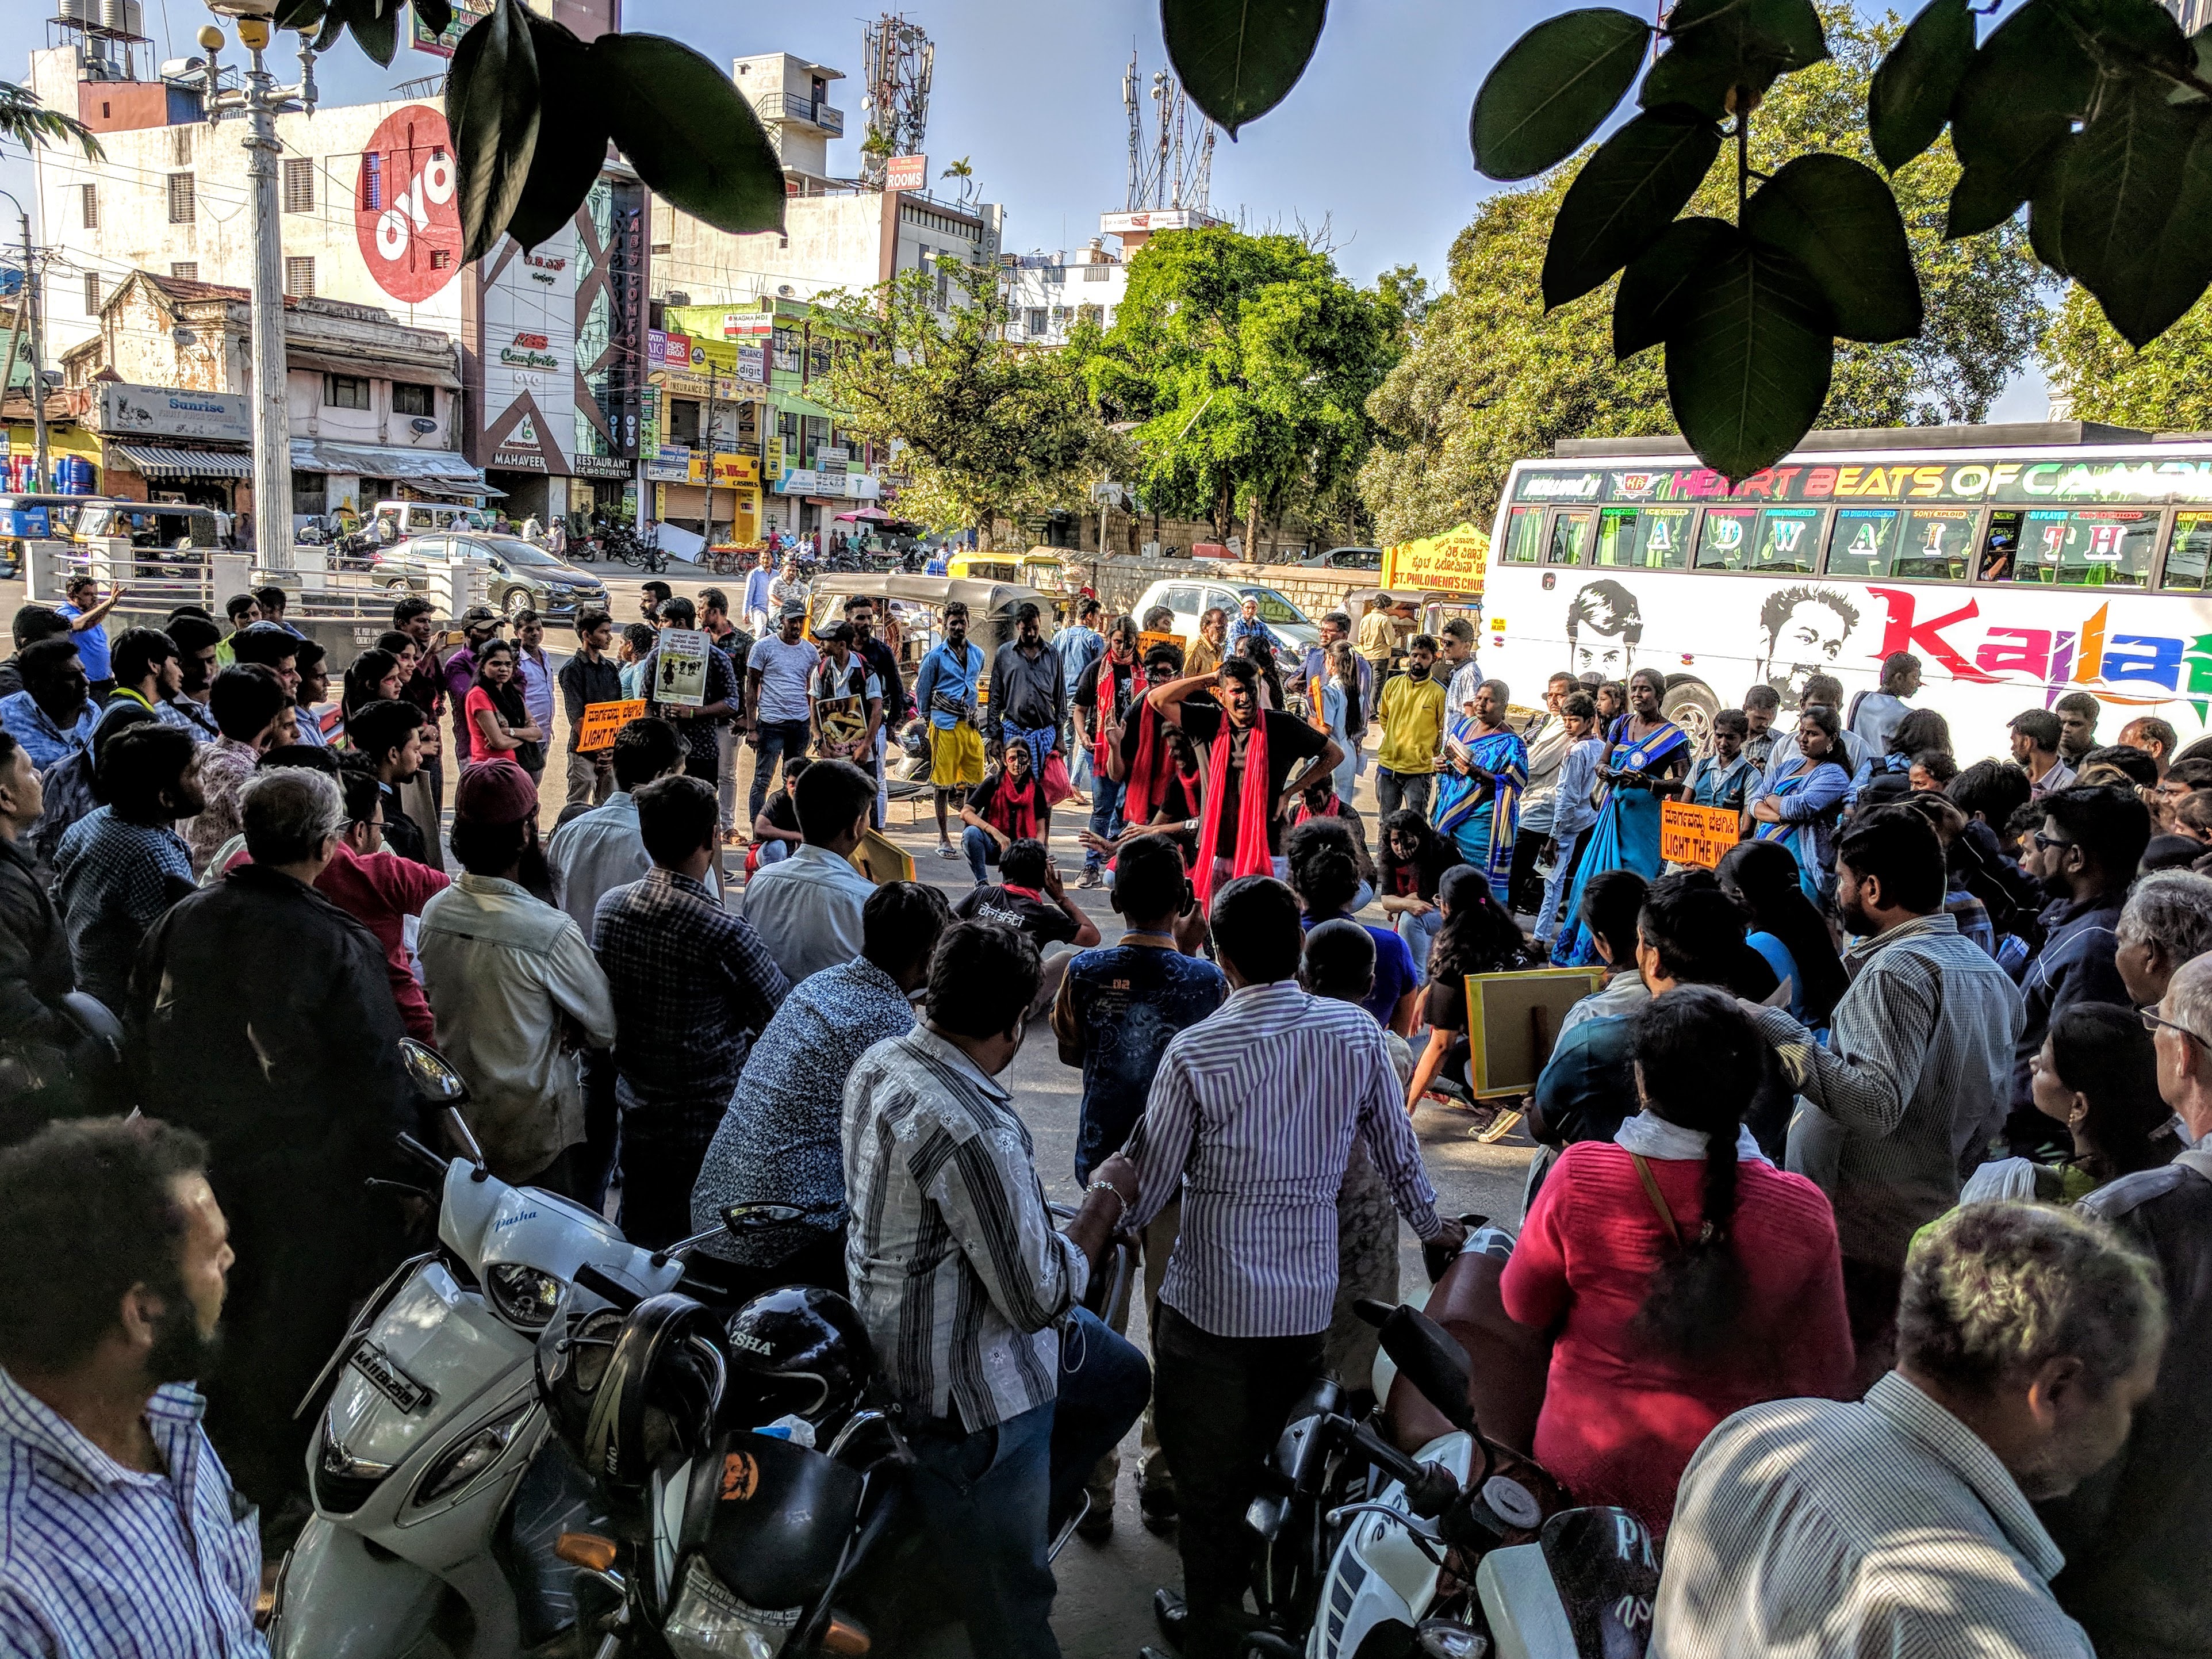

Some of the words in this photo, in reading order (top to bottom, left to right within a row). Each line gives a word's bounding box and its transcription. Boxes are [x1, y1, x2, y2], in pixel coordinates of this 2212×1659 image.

[888, 172, 922, 187] ROOMS
[668, 340, 685, 350] HDFC
[667, 349, 685, 358] ERGO
[739, 363, 761, 377] digit
[670, 381, 701, 394] INSURANCE
[169, 398, 225, 413] Sunrise
[769, 438, 780, 447] Easy
[494, 453, 546, 468] MAHAVEER
[576, 455, 631, 469] RESTAURANT
[605, 469, 620, 477] PURE
[620, 470, 631, 478] VEG
[726, 464, 750, 478] Wear
[1804, 466, 1947, 496] BEATS
[1951, 463, 2023, 497] OF
[583, 728, 608, 748] LIGHT
[608, 726, 622, 744] TH
[1665, 833, 1690, 859] LIGHT
[1693, 838, 1712, 863] THE
[1714, 841, 1734, 863] WA
